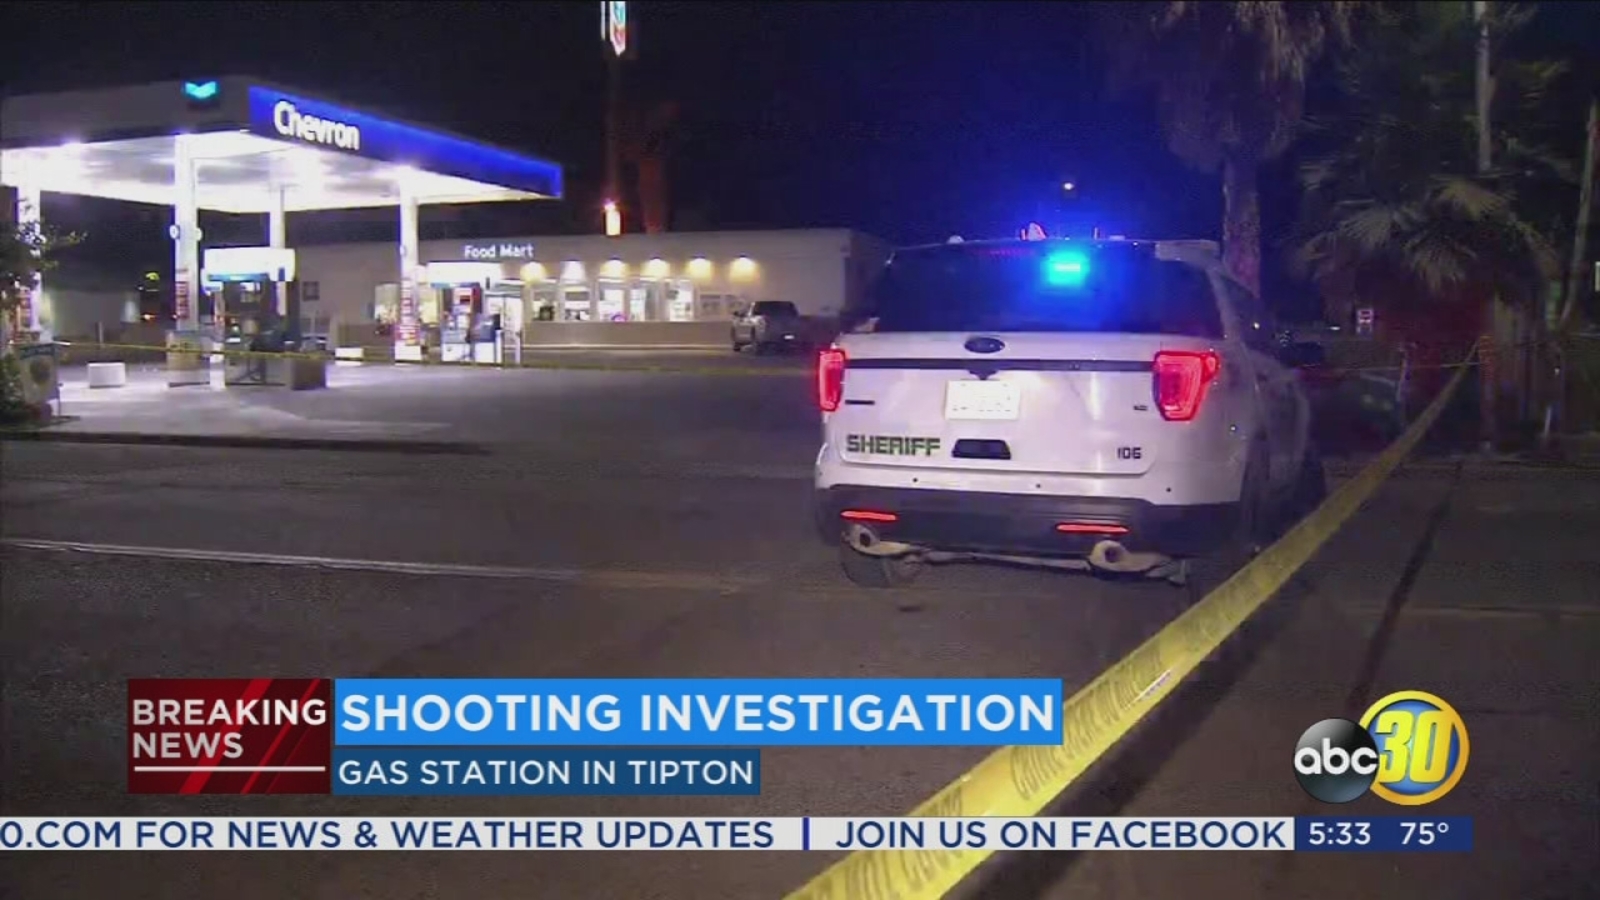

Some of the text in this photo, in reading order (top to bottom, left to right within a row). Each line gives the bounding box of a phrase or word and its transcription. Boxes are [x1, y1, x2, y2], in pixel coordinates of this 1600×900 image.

[273, 100, 360, 151] Chevron
[464, 242, 534, 259] Food Mart
[846, 433, 941, 457] SHERIFF
